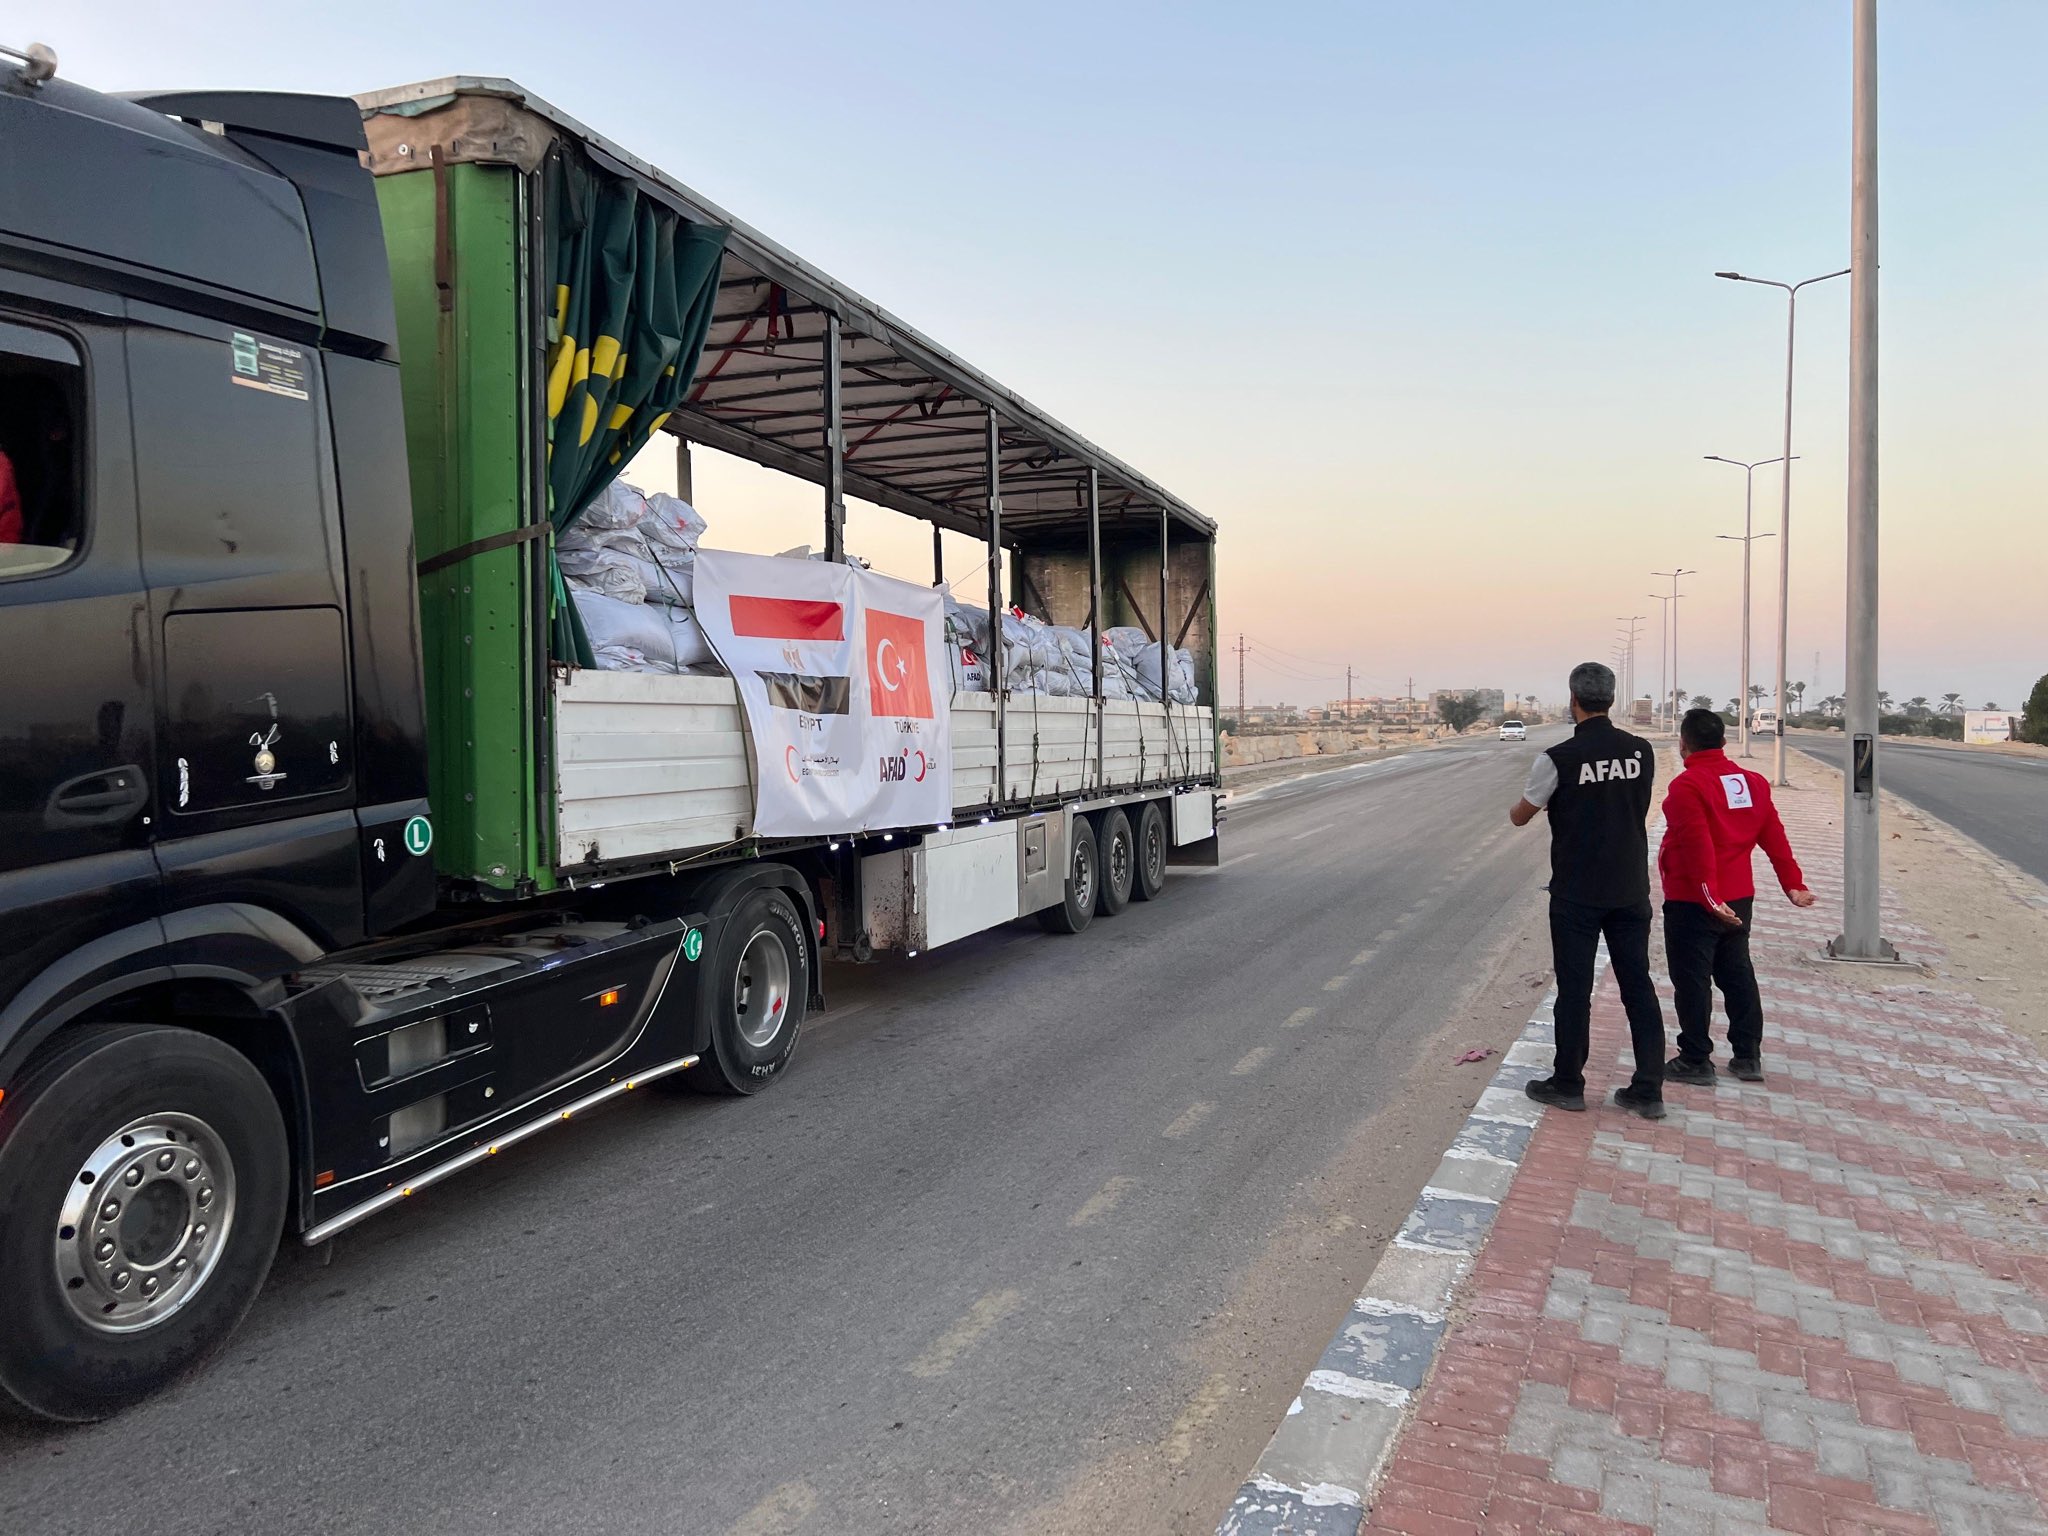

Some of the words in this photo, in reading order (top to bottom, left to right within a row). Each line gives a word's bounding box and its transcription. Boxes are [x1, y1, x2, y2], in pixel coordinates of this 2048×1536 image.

[879, 756, 906, 782] AFAD
[1579, 759, 1641, 785] AFAD
[413, 824, 425, 848] L
